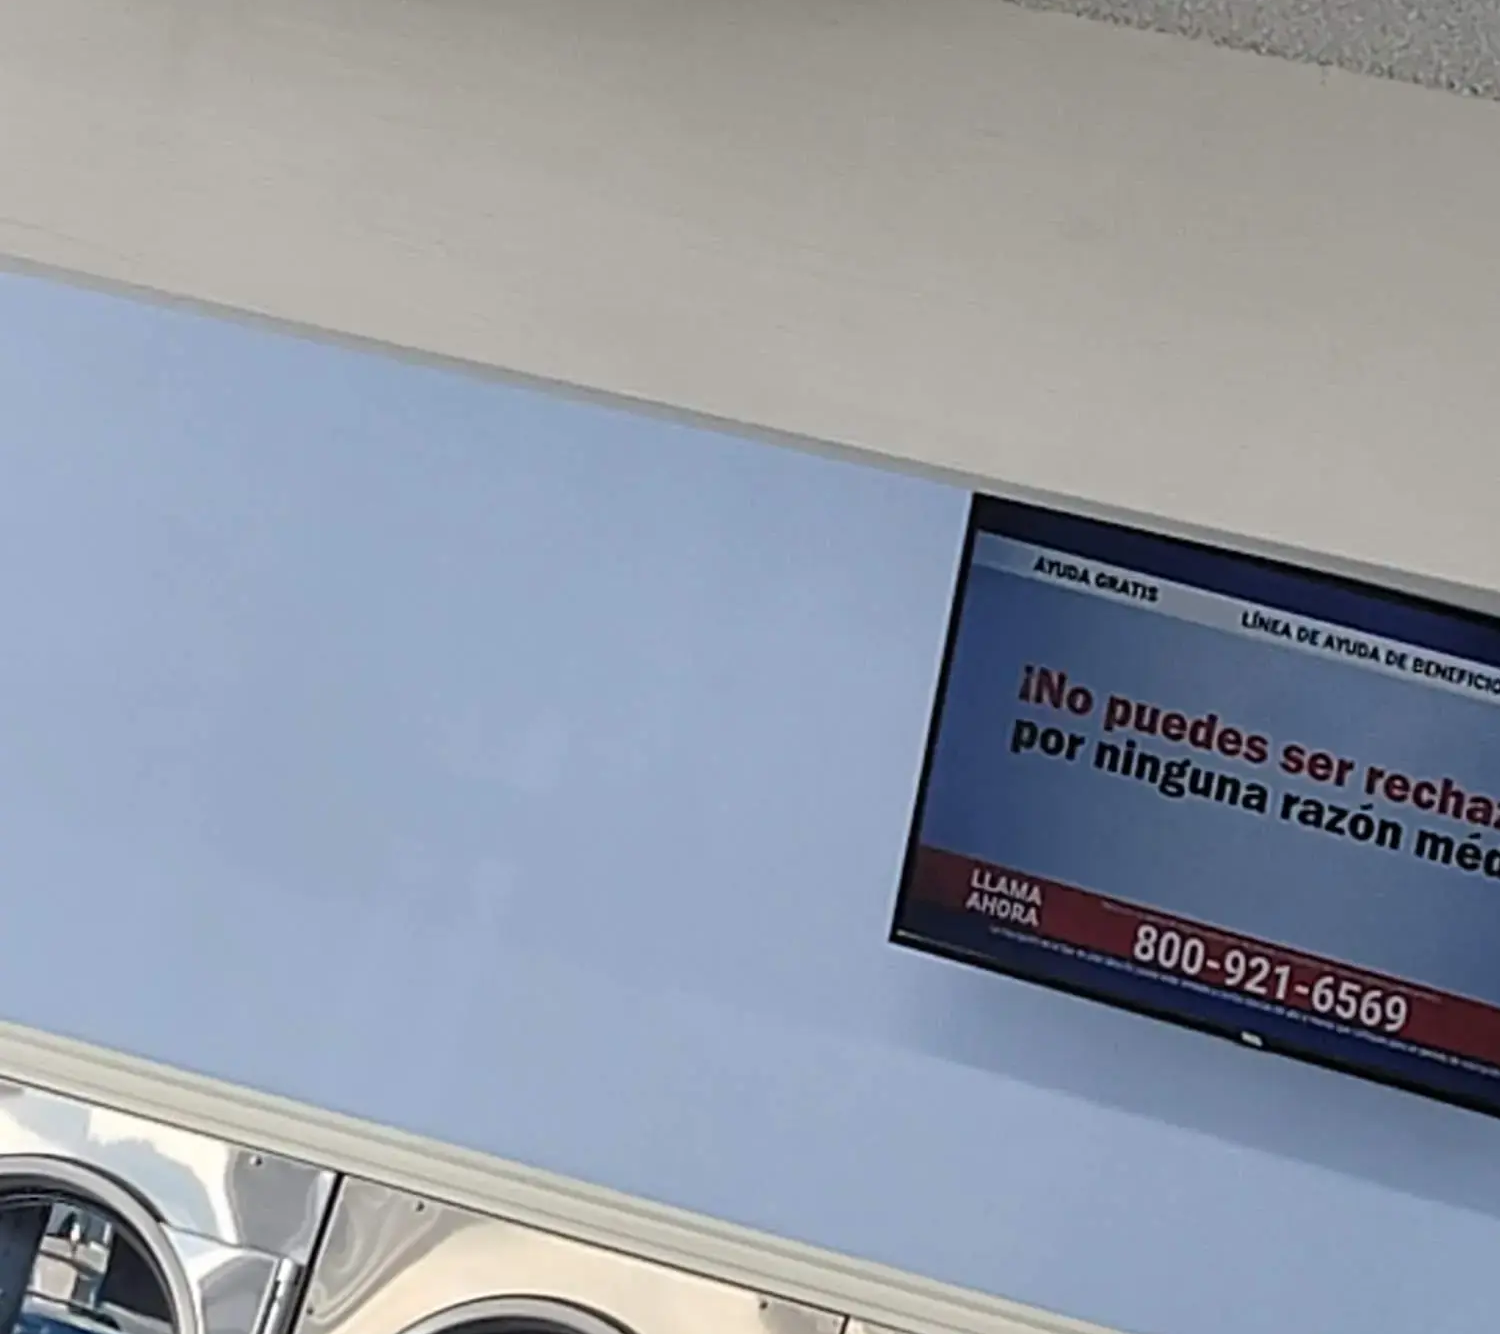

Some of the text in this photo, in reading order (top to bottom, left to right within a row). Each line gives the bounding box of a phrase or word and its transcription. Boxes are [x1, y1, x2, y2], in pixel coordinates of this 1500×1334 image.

[1033, 555, 1159, 602] AYUDA GRATIS
[1240, 609, 1293, 640] LÍNEA
[1297, 626, 1319, 646] DE
[1323, 633, 1381, 663] AYUDA
[1385, 648, 1407, 672] DE
[1102, 694, 1269, 765] puedes
[1278, 743, 1356, 788] ser
[1010, 718, 1086, 762] por
[1093, 739, 1270, 816] ninguna
[1279, 795, 1402, 851] razón
[965, 891, 1039, 928] AHORA
[970, 868, 1042, 907] LLAMA
[1132, 923, 1408, 1034] 800-921-6569
